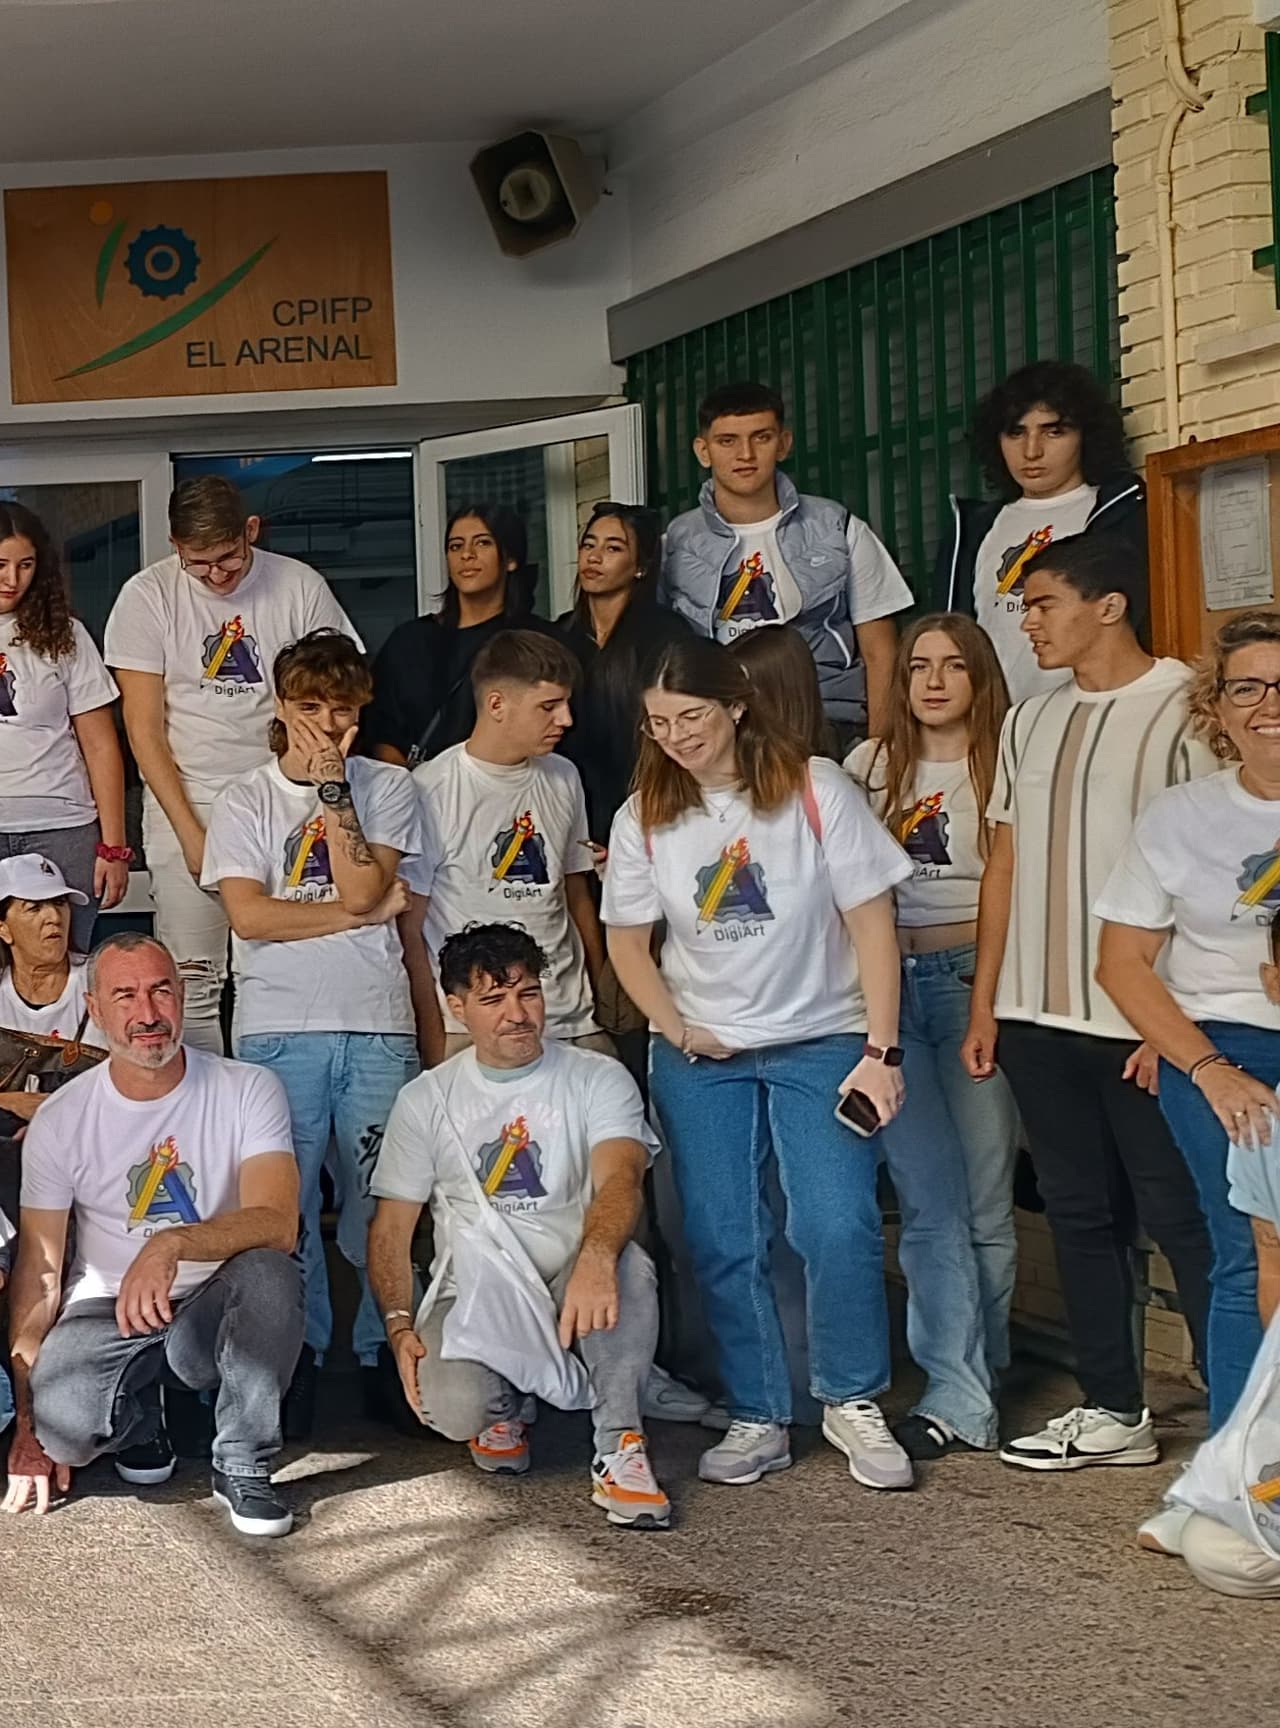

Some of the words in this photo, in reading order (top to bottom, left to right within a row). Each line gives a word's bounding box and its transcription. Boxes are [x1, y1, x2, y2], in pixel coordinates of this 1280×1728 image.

[273, 297, 373, 327] CPIFP
[187, 341, 226, 368] EL
[235, 335, 372, 366] ARENAL
[214, 684, 256, 698] DigiArt
[503, 887, 543, 901] DigiArt
[714, 923, 766, 942] DigiArt
